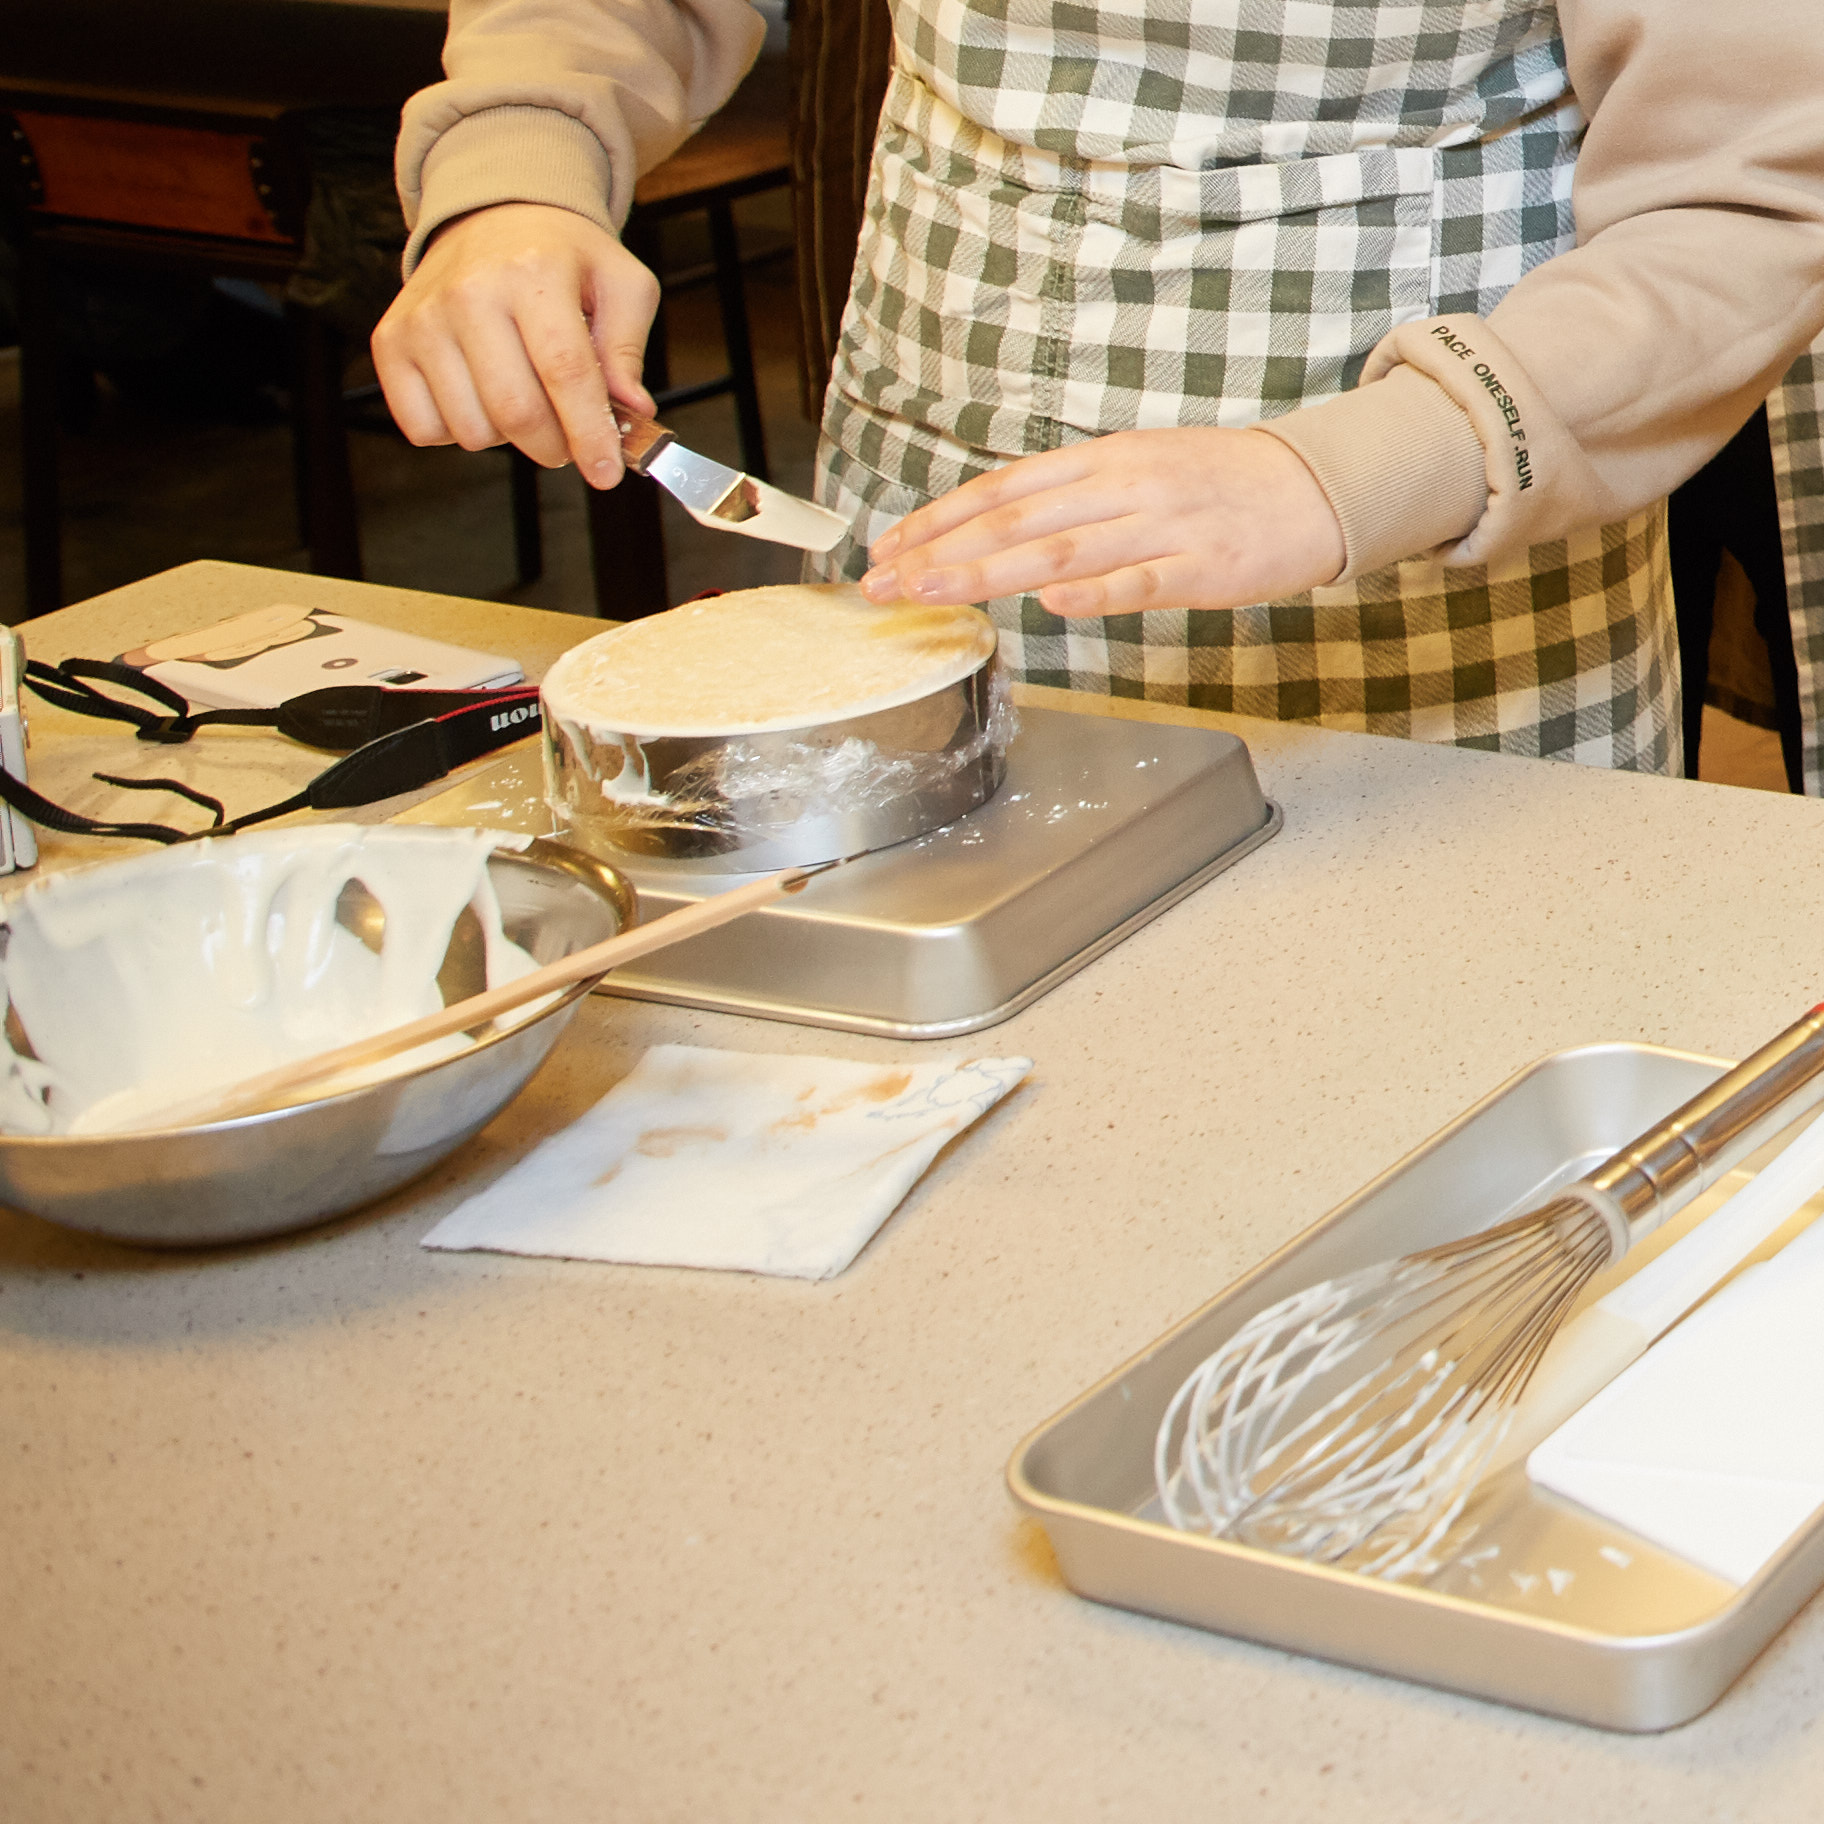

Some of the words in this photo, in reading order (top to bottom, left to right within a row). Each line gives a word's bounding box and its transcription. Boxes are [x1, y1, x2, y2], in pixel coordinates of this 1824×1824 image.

[1431, 325, 1476, 361] PACE
[1473, 362, 1525, 442] ONESELF
[489, 701, 541, 732] non
